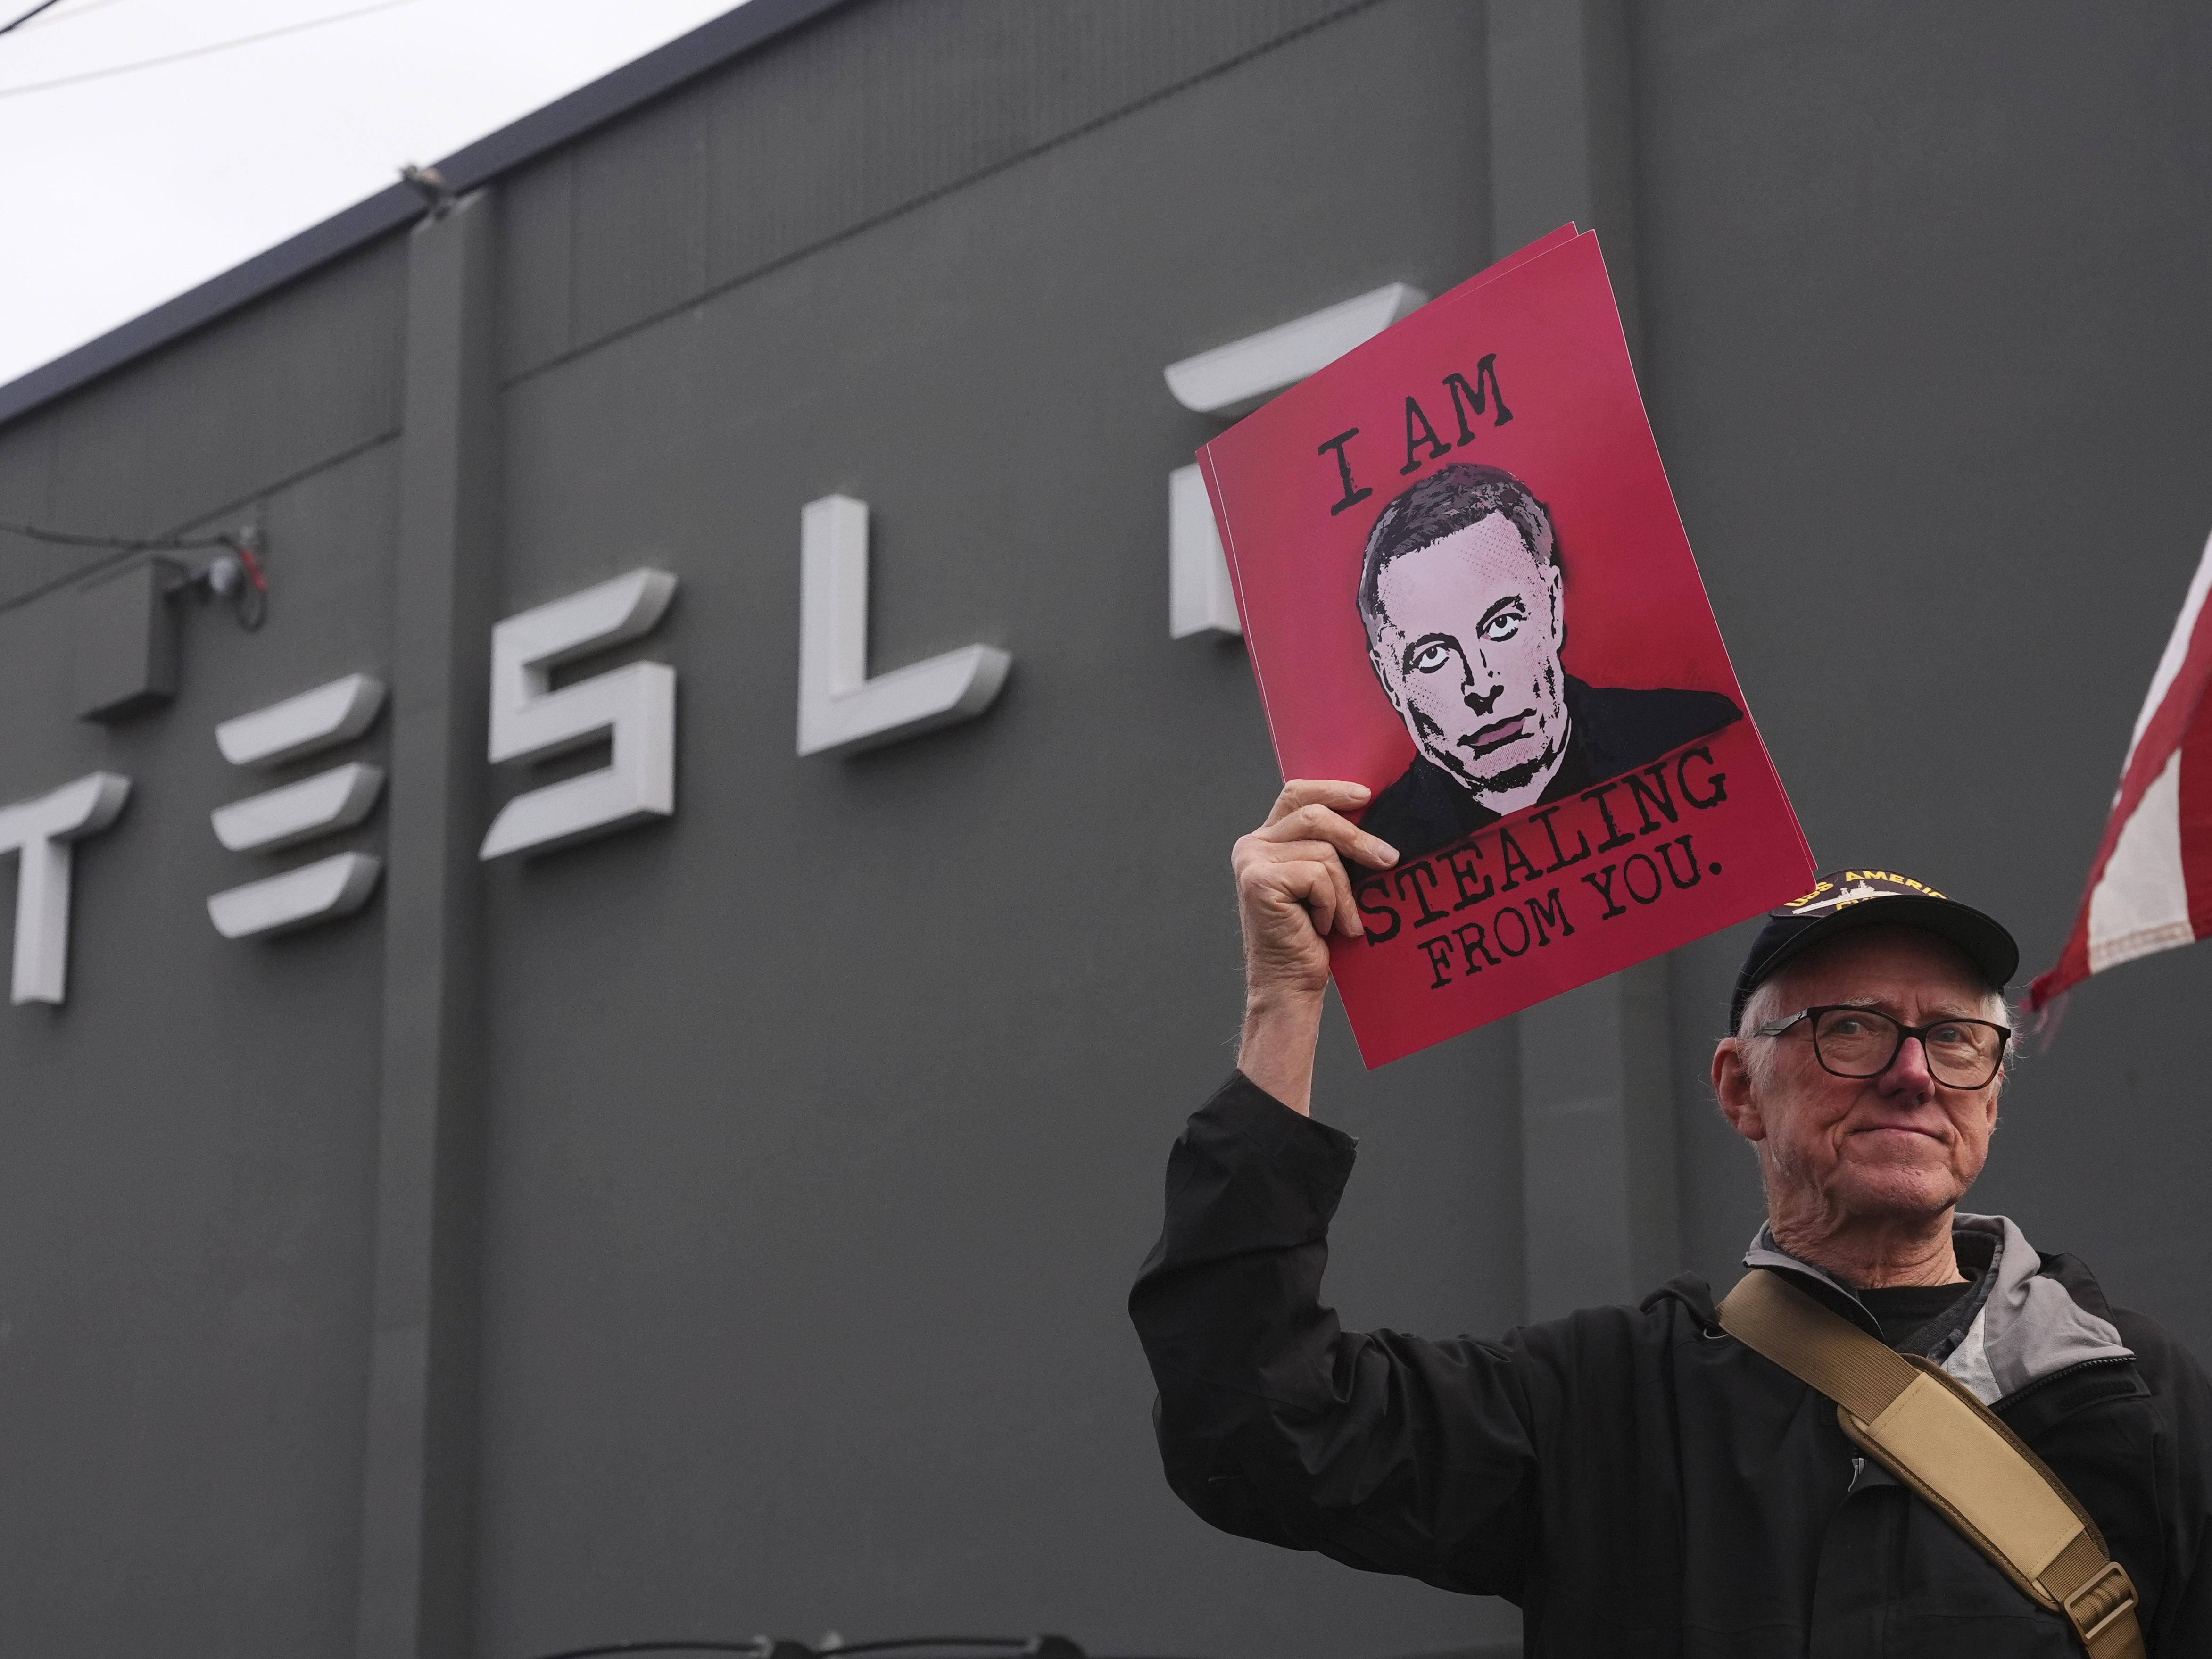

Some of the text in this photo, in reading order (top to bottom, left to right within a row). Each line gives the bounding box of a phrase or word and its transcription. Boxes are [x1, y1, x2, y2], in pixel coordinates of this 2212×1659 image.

[1318, 353, 1514, 516] I AM
[1356, 747, 1728, 946] STEALING
[1417, 834, 1722, 990] FROM YOU.
[1784, 881, 1834, 907] USS
